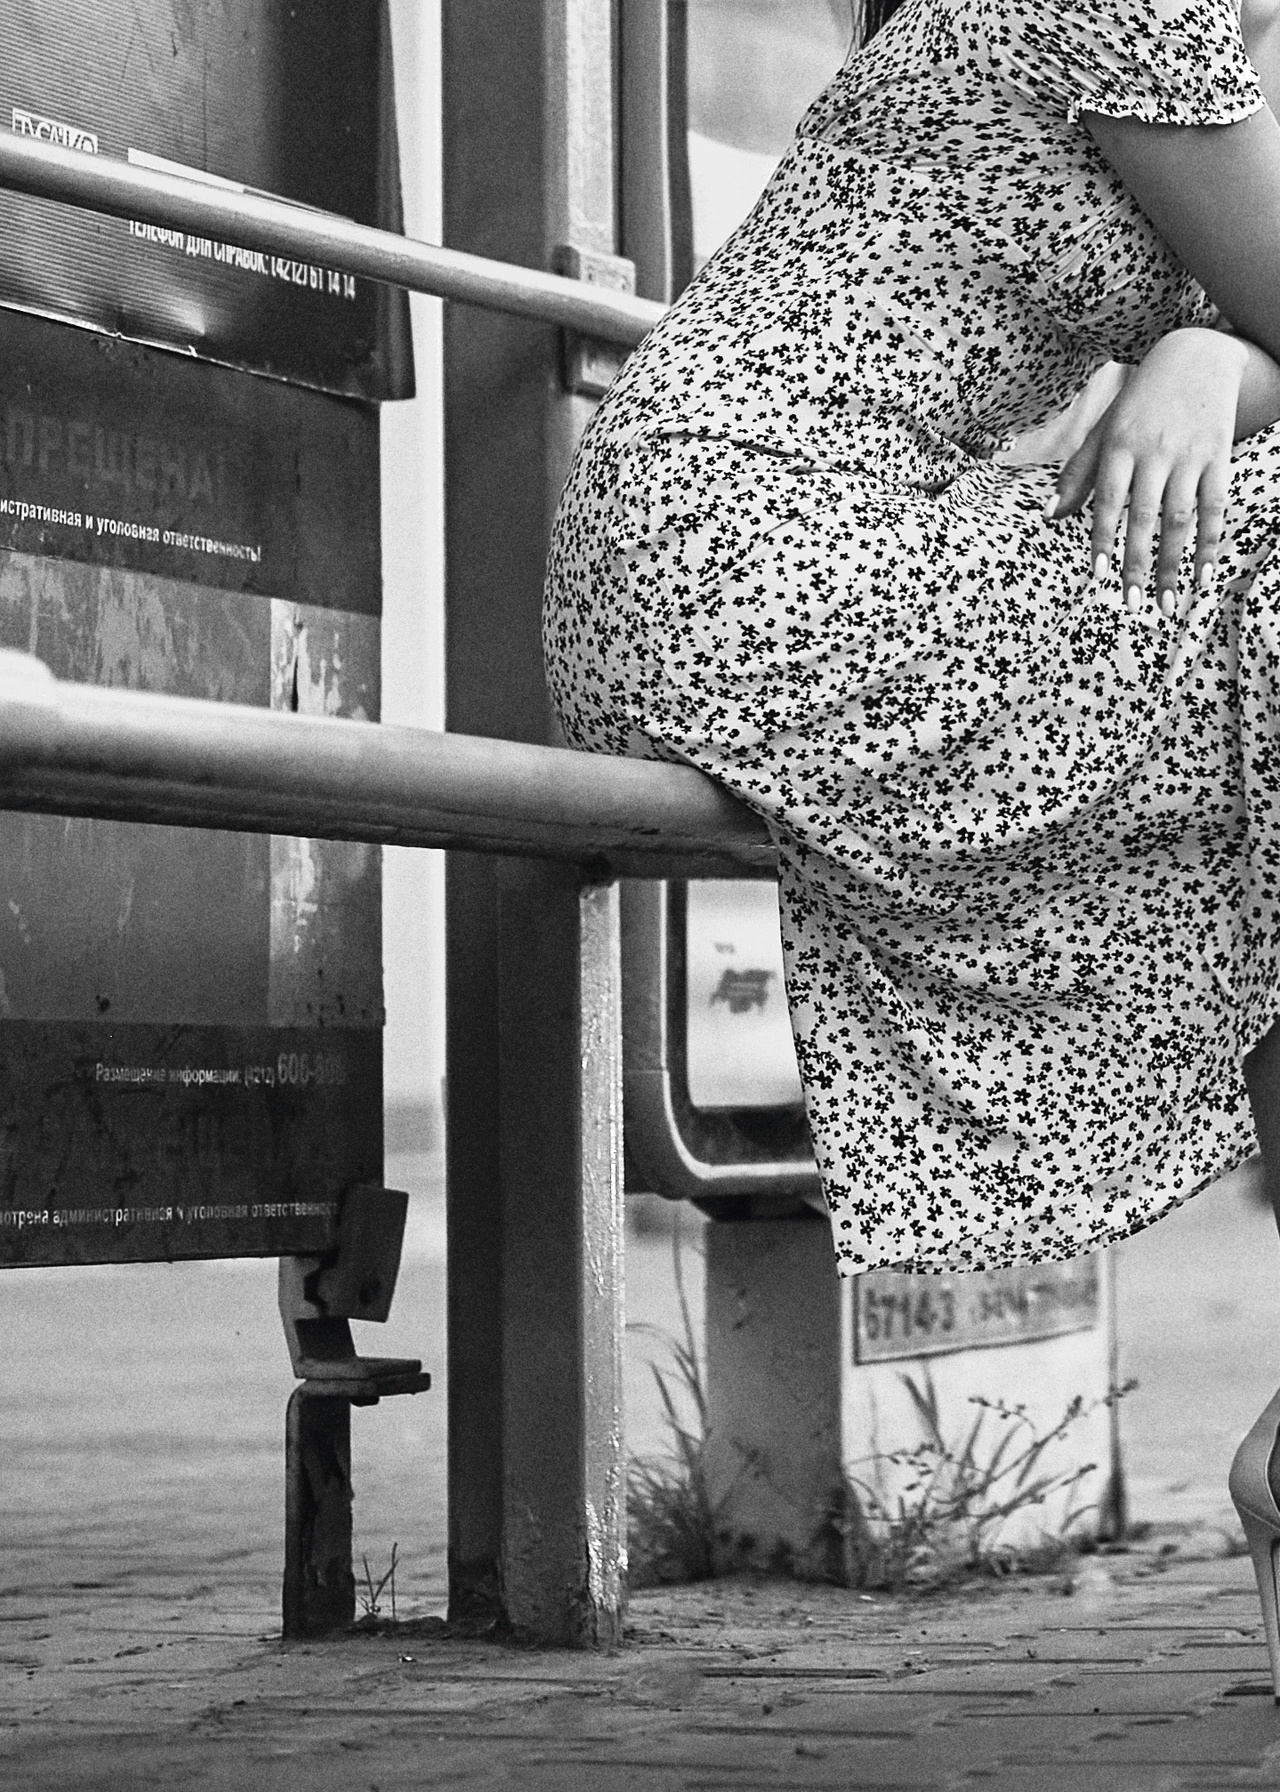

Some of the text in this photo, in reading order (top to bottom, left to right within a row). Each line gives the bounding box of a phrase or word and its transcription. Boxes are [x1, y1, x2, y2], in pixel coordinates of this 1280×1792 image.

[85, 515, 94, 530] и
[96, 516, 160, 543] уголовная
[163, 529, 262, 562] ответственность!
